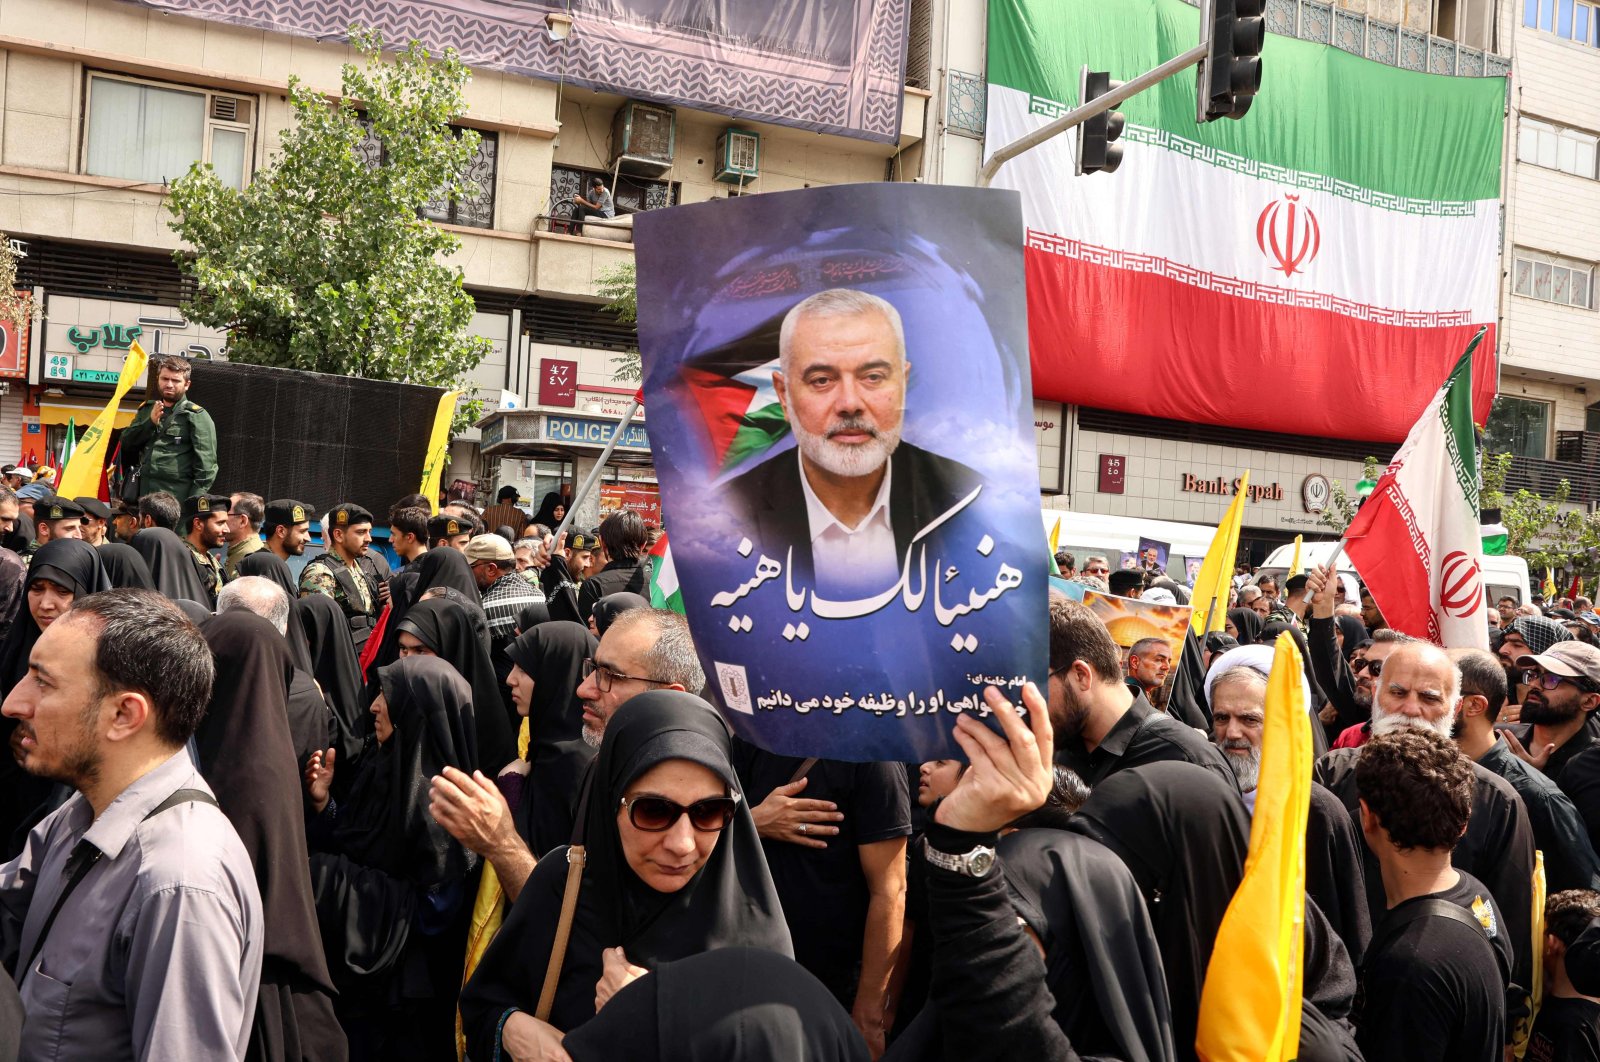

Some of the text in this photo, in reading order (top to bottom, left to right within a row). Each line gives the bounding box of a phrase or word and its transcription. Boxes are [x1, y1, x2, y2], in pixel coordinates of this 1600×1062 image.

[50, 355, 68, 366] 49
[550, 364, 569, 376] 47
[550, 420, 611, 442] POLICE
[1034, 420, 1054, 431] موس
[1107, 458, 1120, 467] 45
[1183, 473, 1284, 502] Bank Sepah
[711, 536, 782, 632] هنیه
[782, 545, 810, 641] یا
[1008, 675, 1027, 690] امام
[756, 689, 792, 710] دانیم
[795, 699, 820, 714] می
[822, 692, 855, 714] خود
[858, 693, 906, 717] وظیفه
[908, 692, 926, 715] را
[929, 689, 944, 715] او
